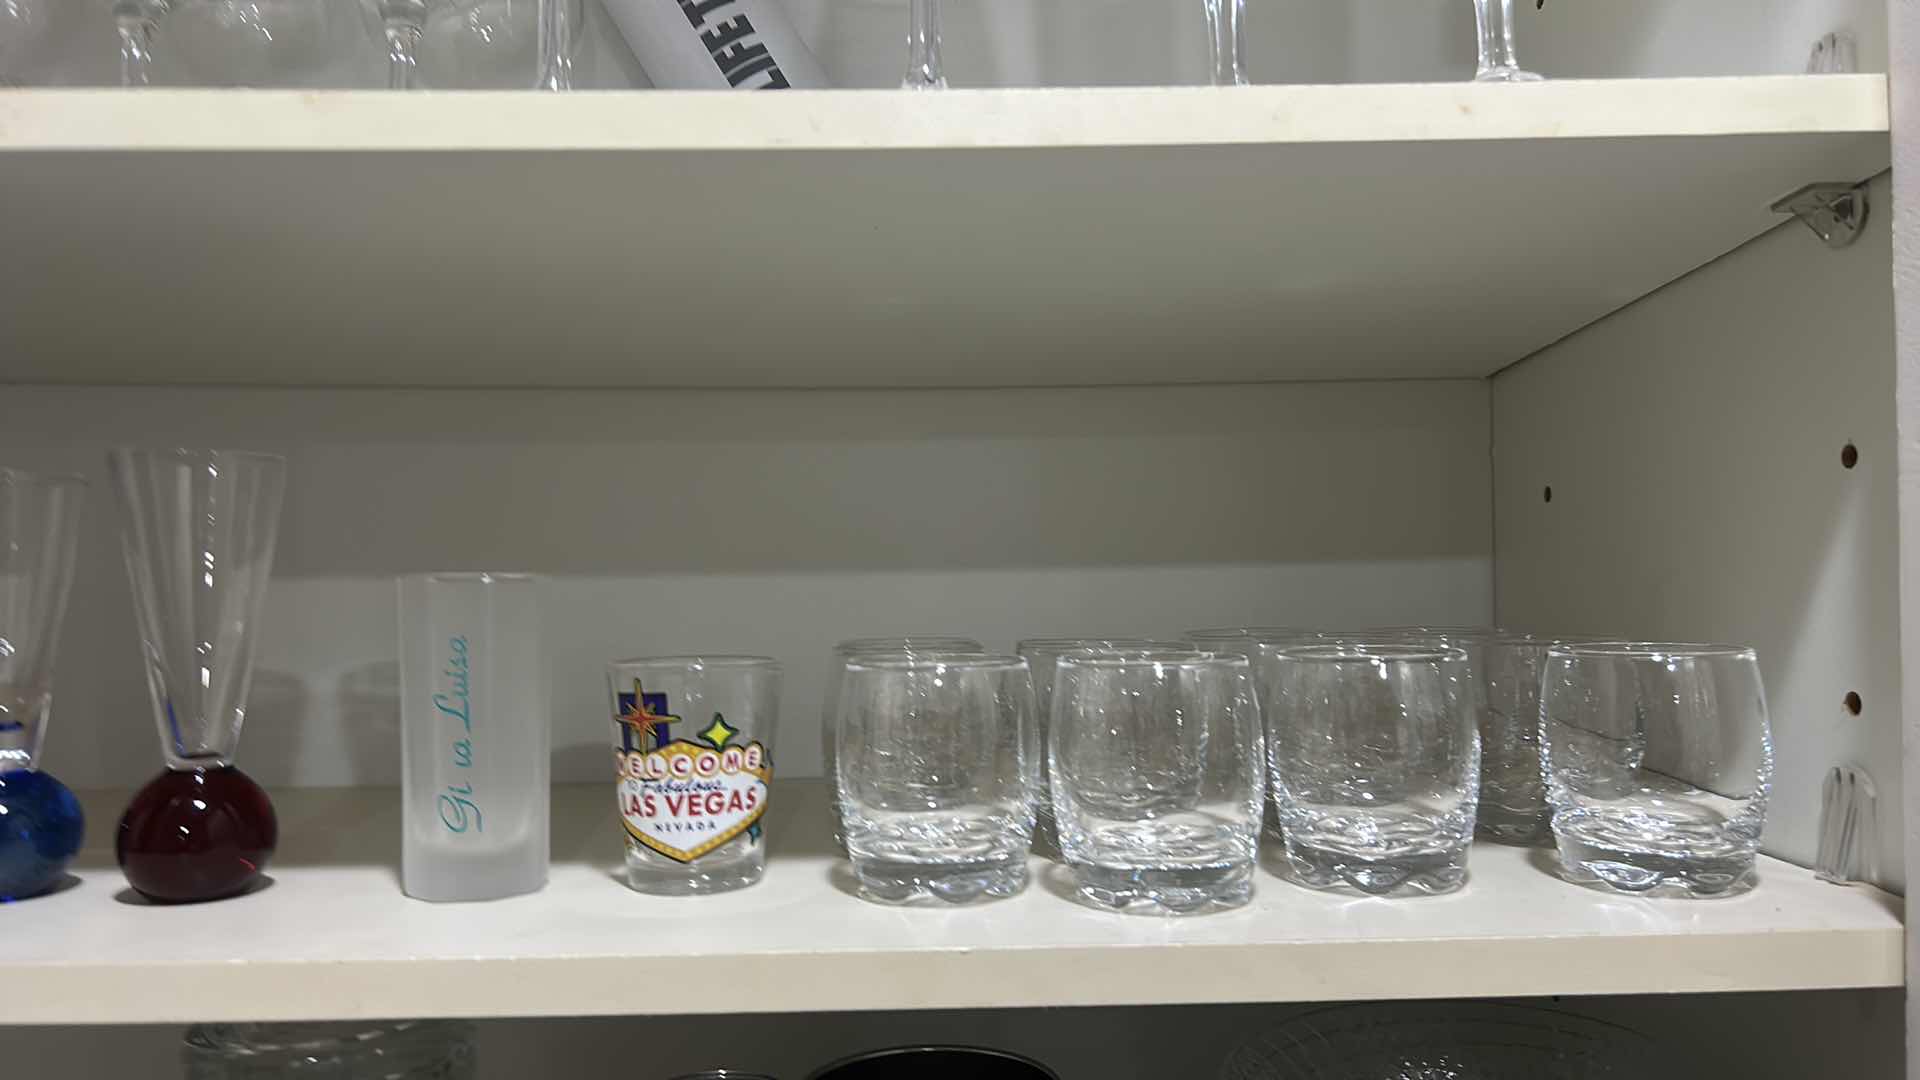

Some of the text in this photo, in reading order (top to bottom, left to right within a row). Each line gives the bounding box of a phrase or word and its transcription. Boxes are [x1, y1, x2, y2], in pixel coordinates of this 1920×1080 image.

[432, 635, 471, 733] Luisa
[622, 787, 757, 818] LAS VEGAS
[655, 821, 717, 833] NEVADA
